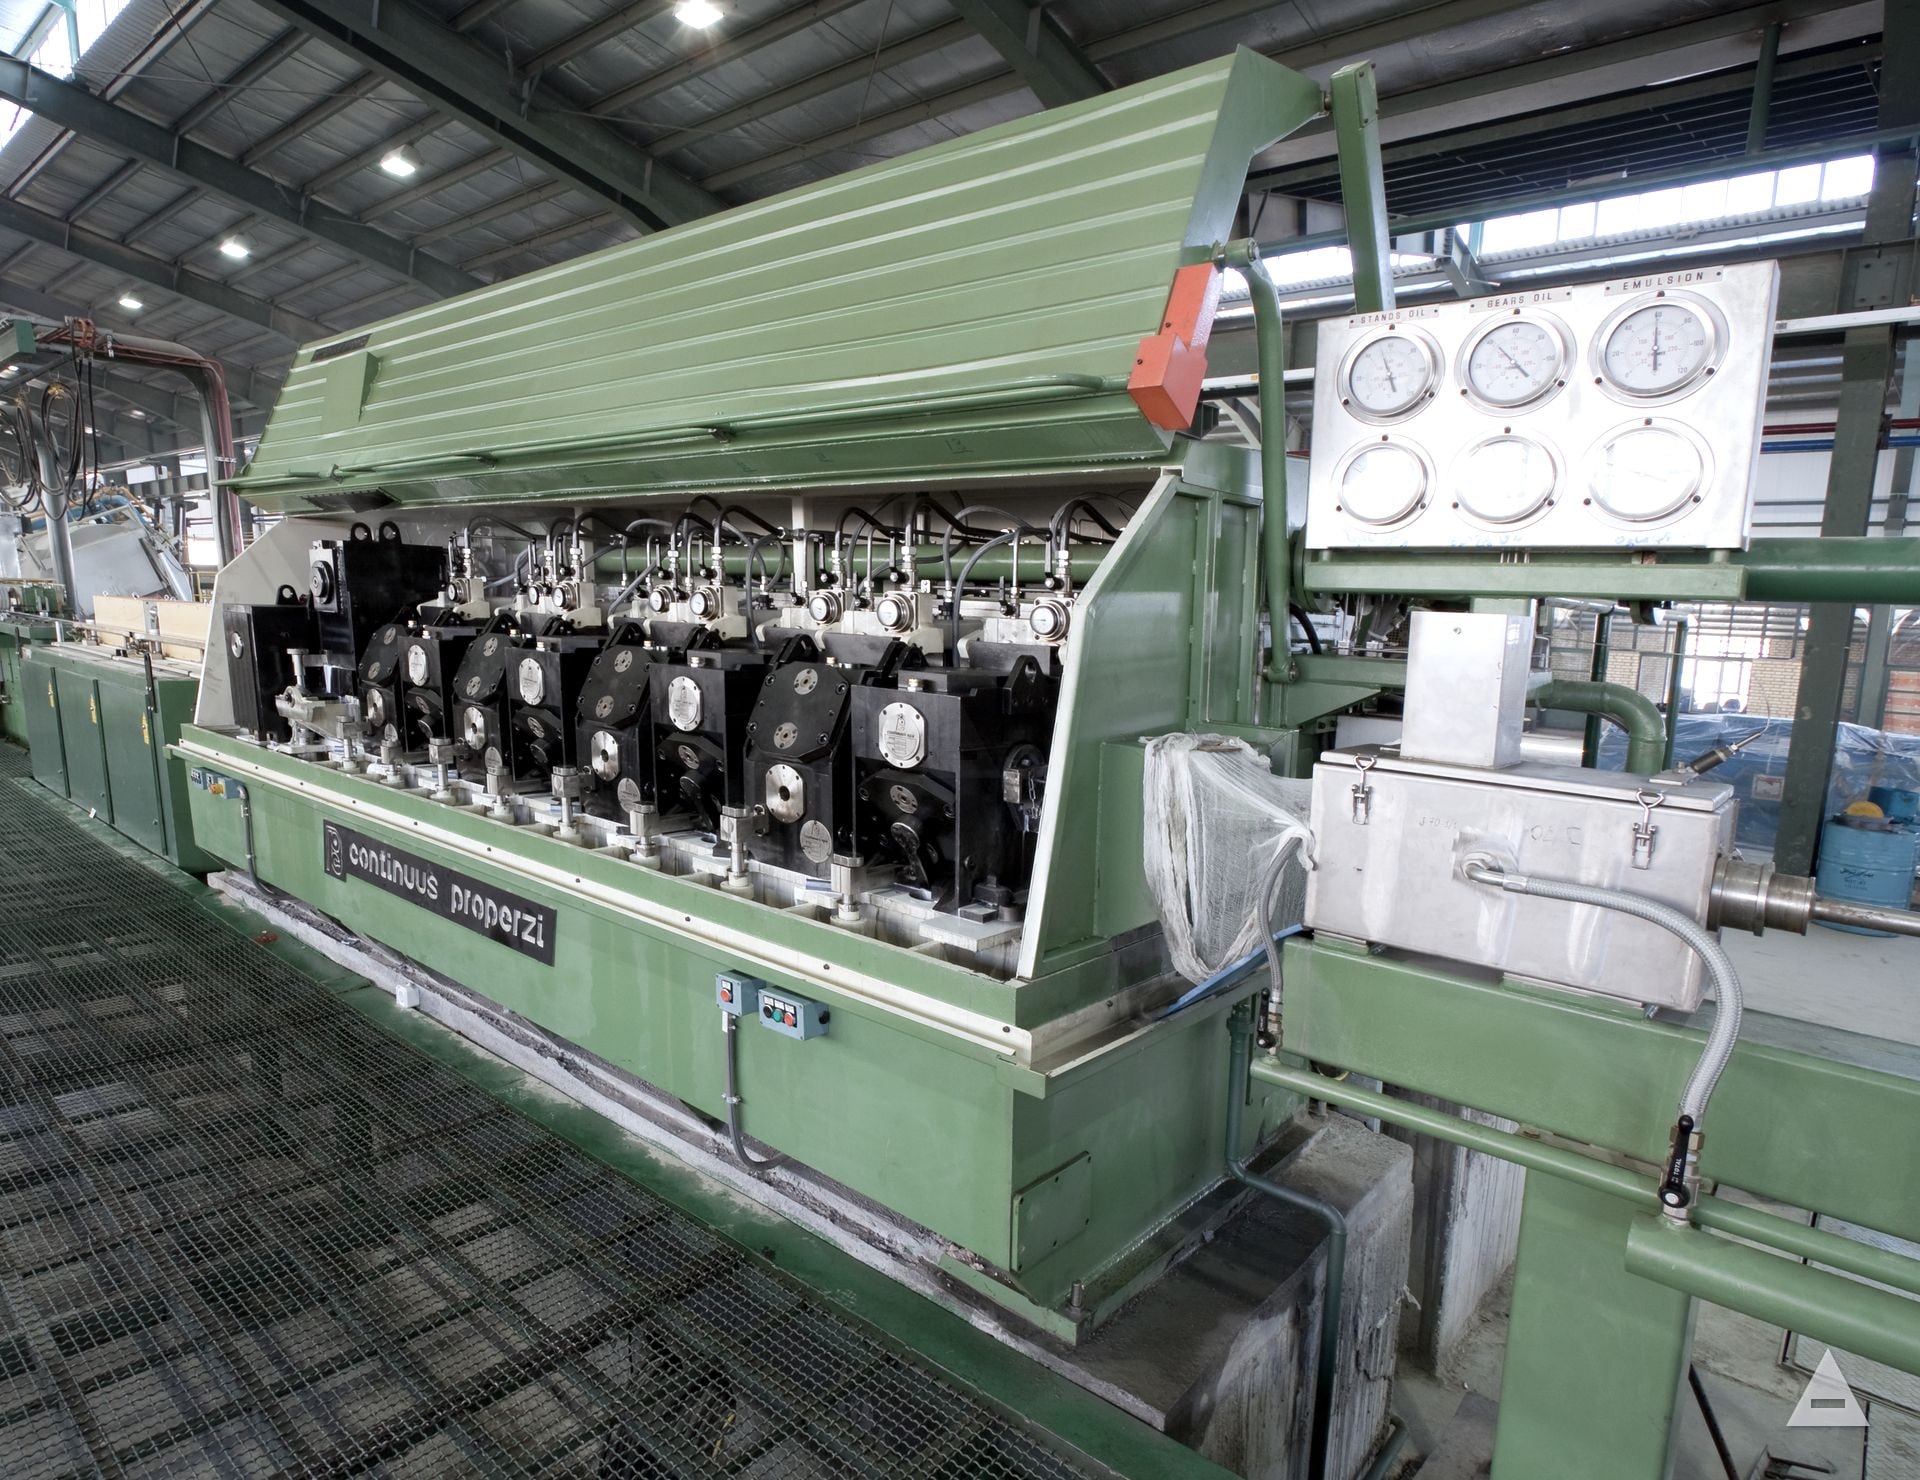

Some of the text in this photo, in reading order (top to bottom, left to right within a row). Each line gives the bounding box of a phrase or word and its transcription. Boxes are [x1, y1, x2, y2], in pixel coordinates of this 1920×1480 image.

[1623, 271, 1704, 291] EMULSION
[1487, 292, 1553, 308] GEARS OIL
[1360, 309, 1425, 324] STANDS OIL
[350, 842, 545, 948] continuus properzi
[1673, 1158, 1682, 1176] TOTAL
